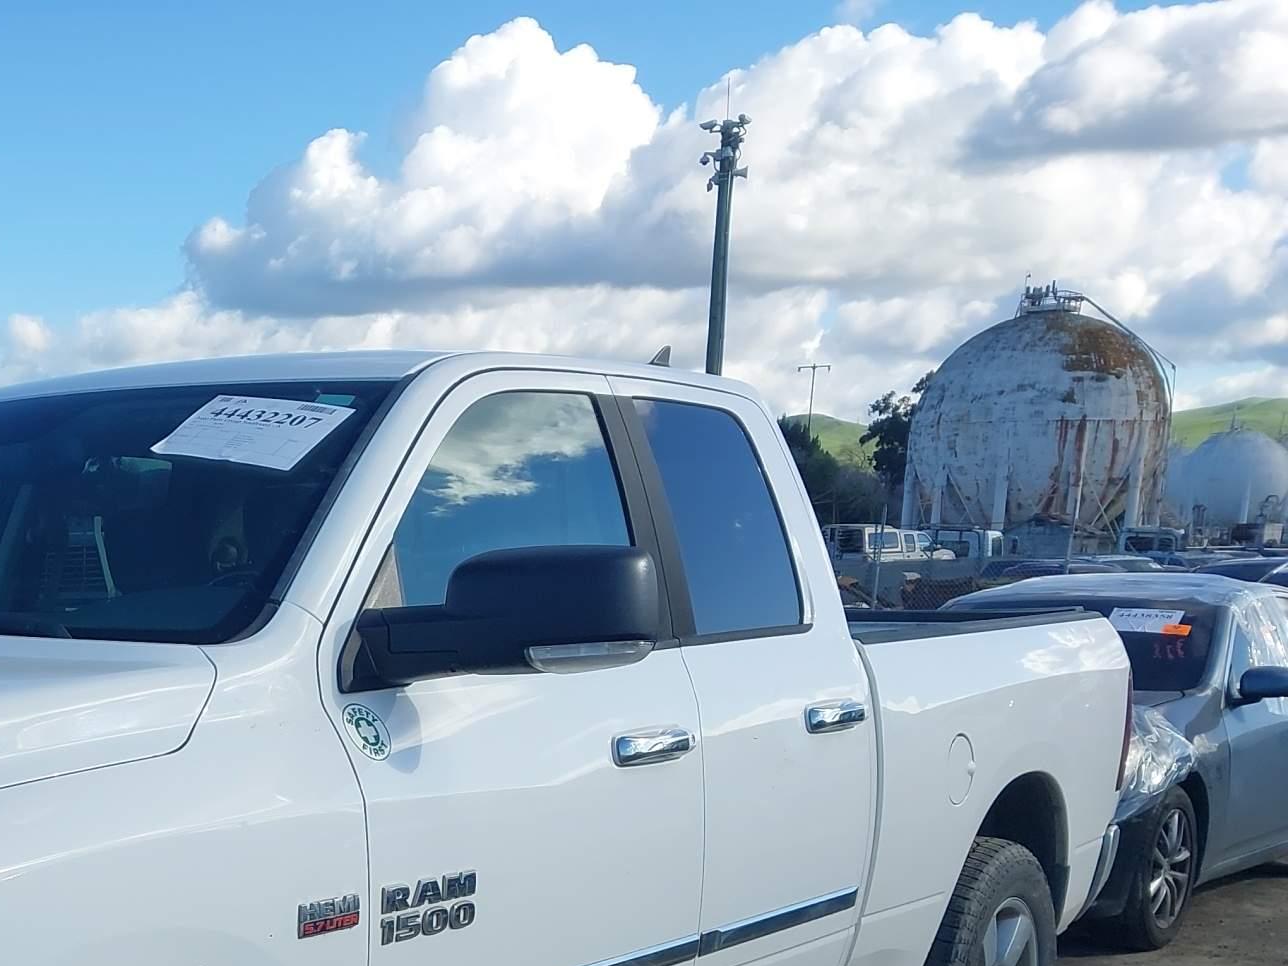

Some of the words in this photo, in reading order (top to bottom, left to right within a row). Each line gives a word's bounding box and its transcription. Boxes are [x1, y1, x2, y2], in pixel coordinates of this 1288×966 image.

[210, 406, 322, 428] 44432207
[346, 708, 378, 726] SAFETY
[363, 740, 388, 757] FIRST
[381, 870, 476, 915] RAM
[297, 893, 361, 923] HEMI
[381, 900, 476, 946] 1500
